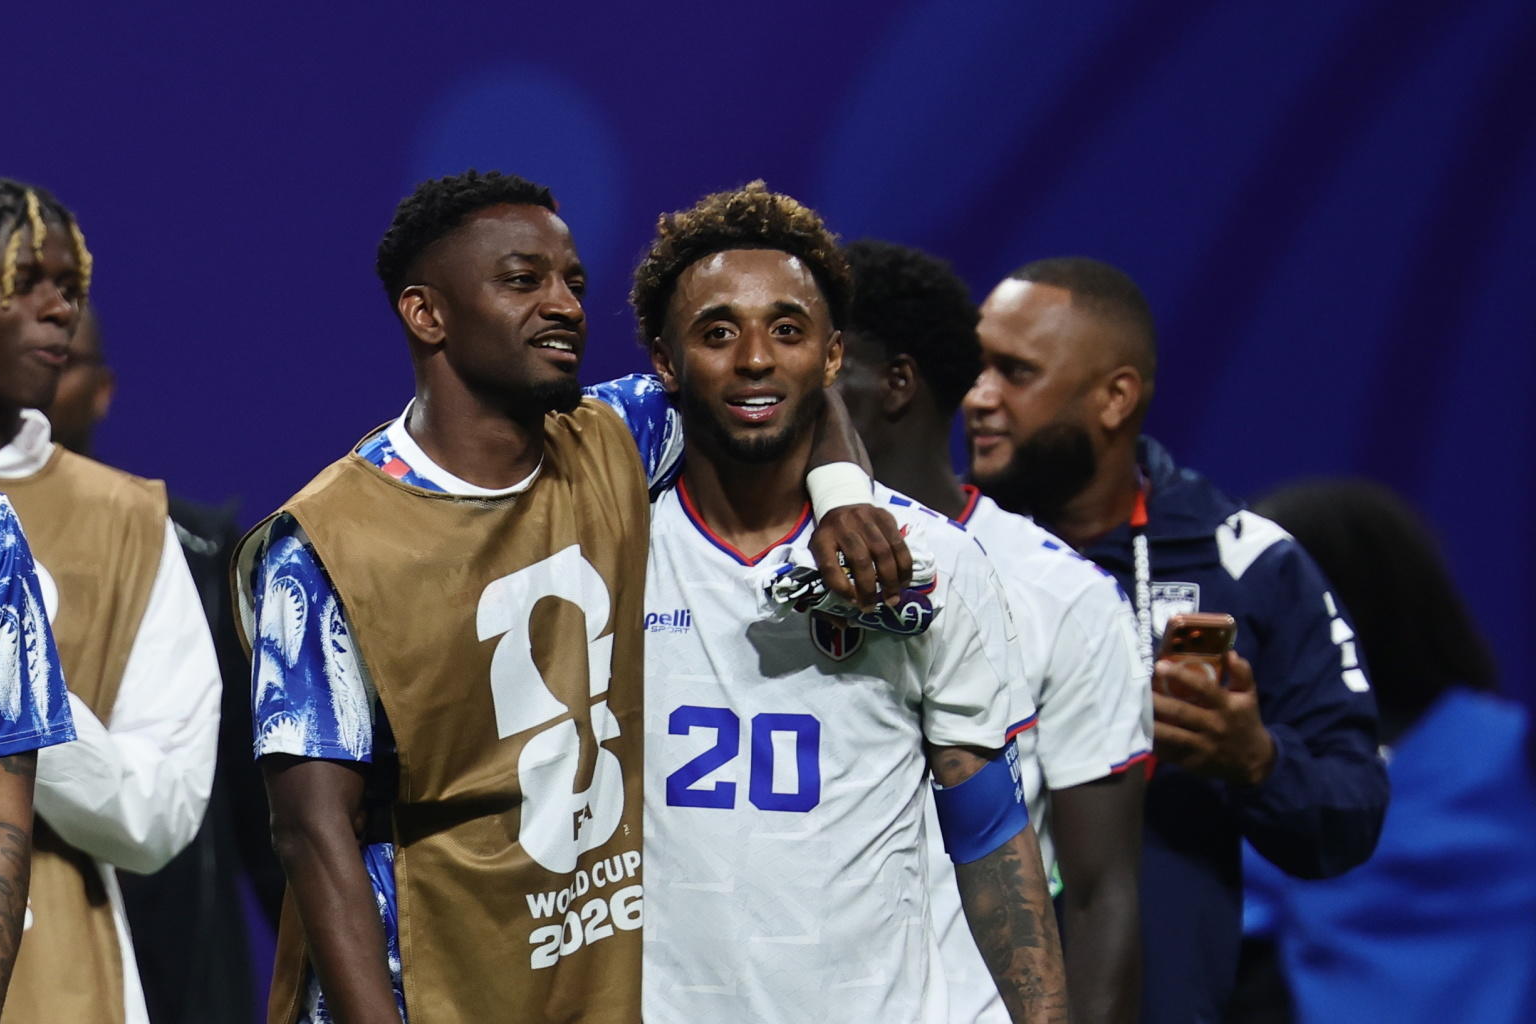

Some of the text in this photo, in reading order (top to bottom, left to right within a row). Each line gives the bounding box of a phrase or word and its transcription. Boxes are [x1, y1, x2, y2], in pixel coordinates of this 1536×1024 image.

[643, 609, 691, 630] pelli
[651, 625, 689, 634] SPORT
[666, 704, 821, 813] 20
[525, 850, 641, 919] WOLD CUP
[529, 885, 644, 970] 2026
